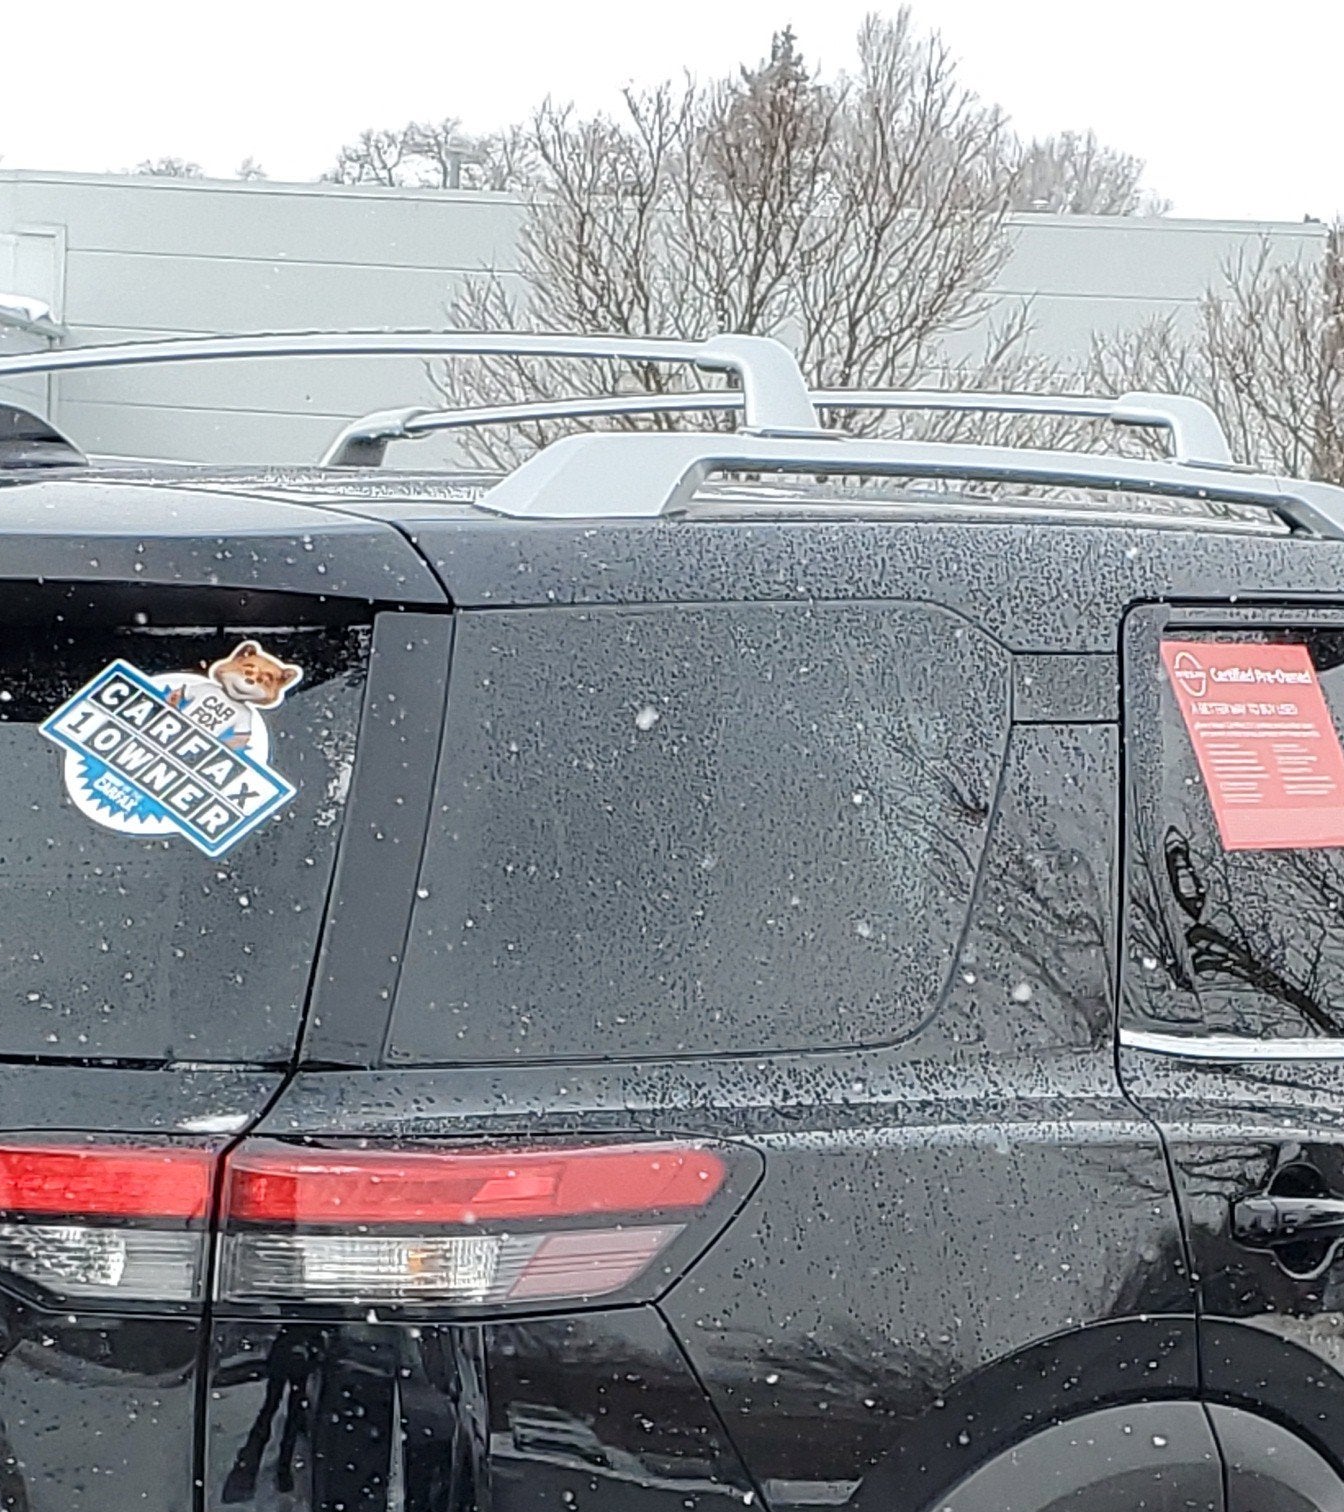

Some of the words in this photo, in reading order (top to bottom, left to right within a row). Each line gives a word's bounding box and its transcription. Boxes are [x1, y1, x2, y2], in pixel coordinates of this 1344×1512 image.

[189, 707, 221, 732] FOX
[202, 696, 236, 721] CAR
[66, 711, 94, 734] 1
[93, 728, 231, 833] OWNER
[101, 683, 260, 810] CARFAX
